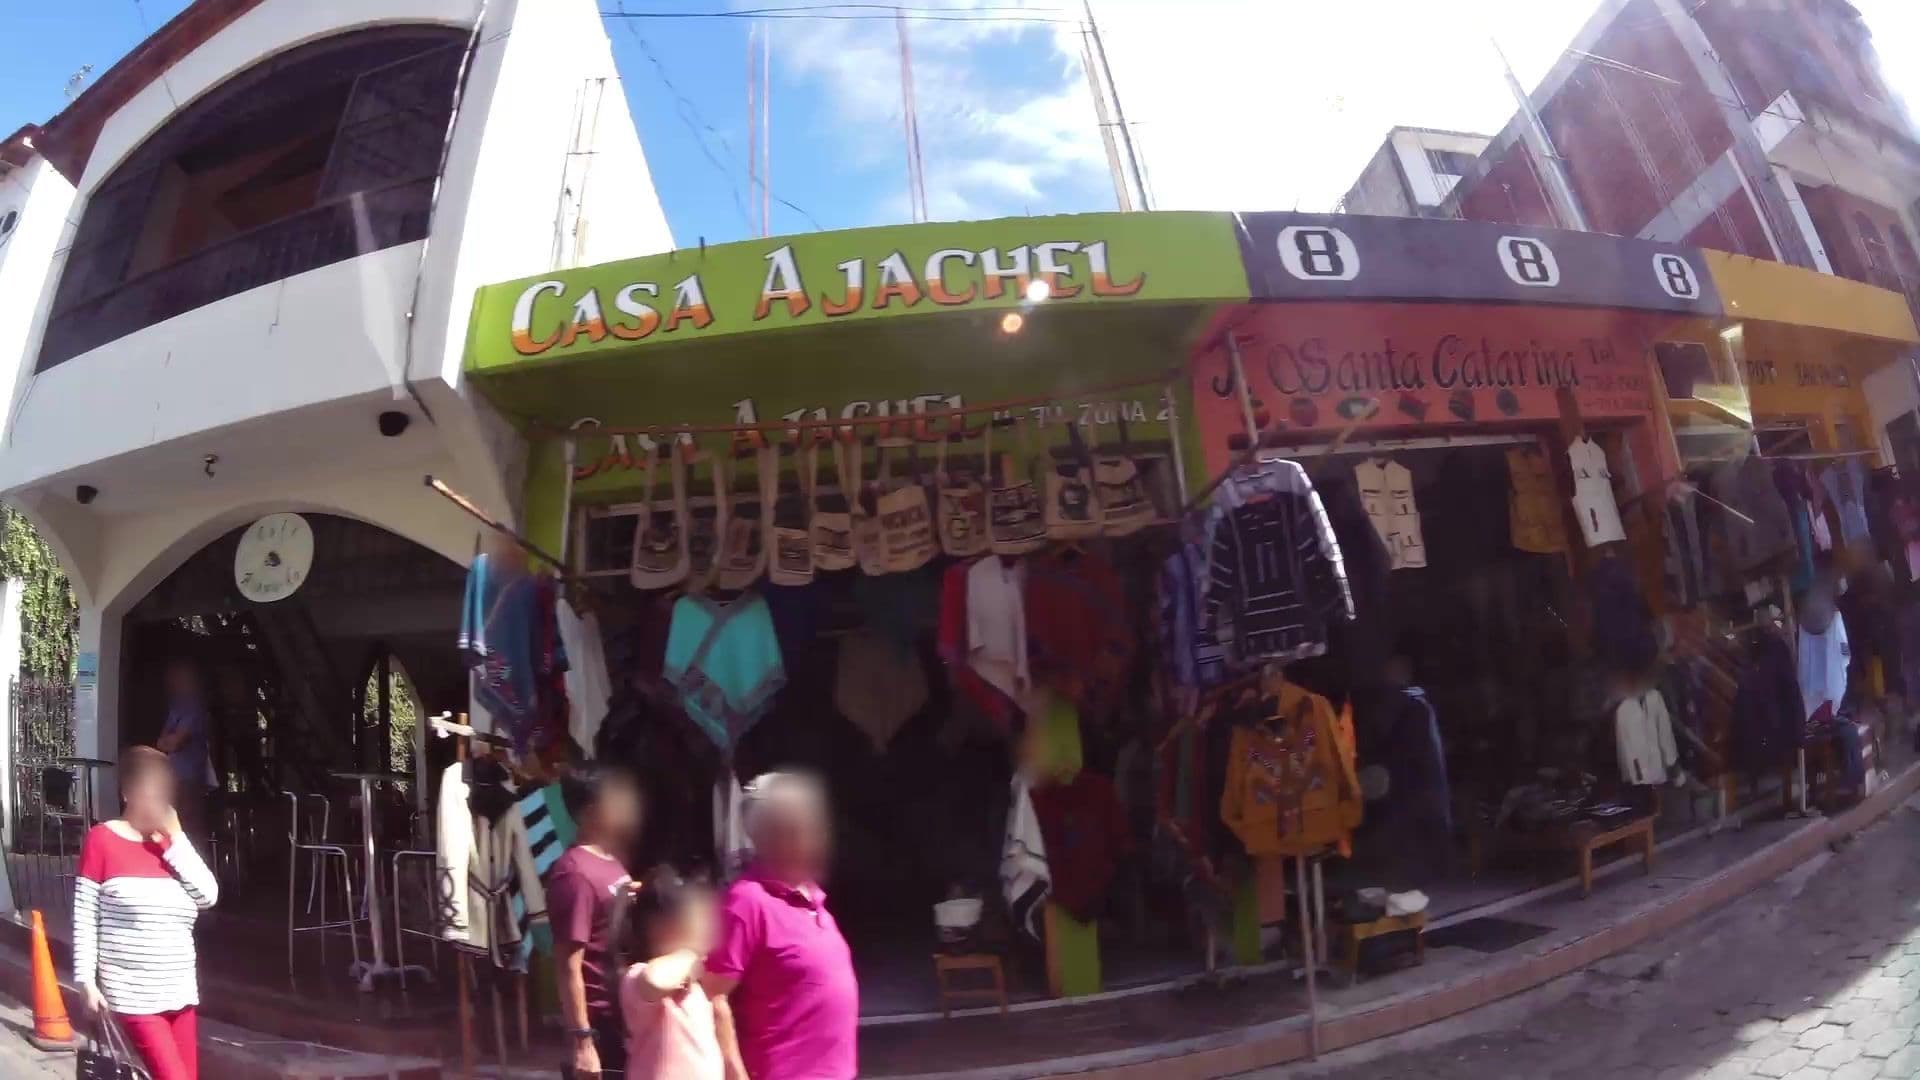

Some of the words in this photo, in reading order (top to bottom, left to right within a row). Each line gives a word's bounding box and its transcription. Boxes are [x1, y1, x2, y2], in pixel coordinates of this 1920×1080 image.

[1293, 228, 1345, 278] 8
[1509, 238, 1551, 283] 8
[1660, 256, 1694, 296] 8
[511, 278, 716, 356] CASA
[1431, 333, 1581, 389] Catarina
